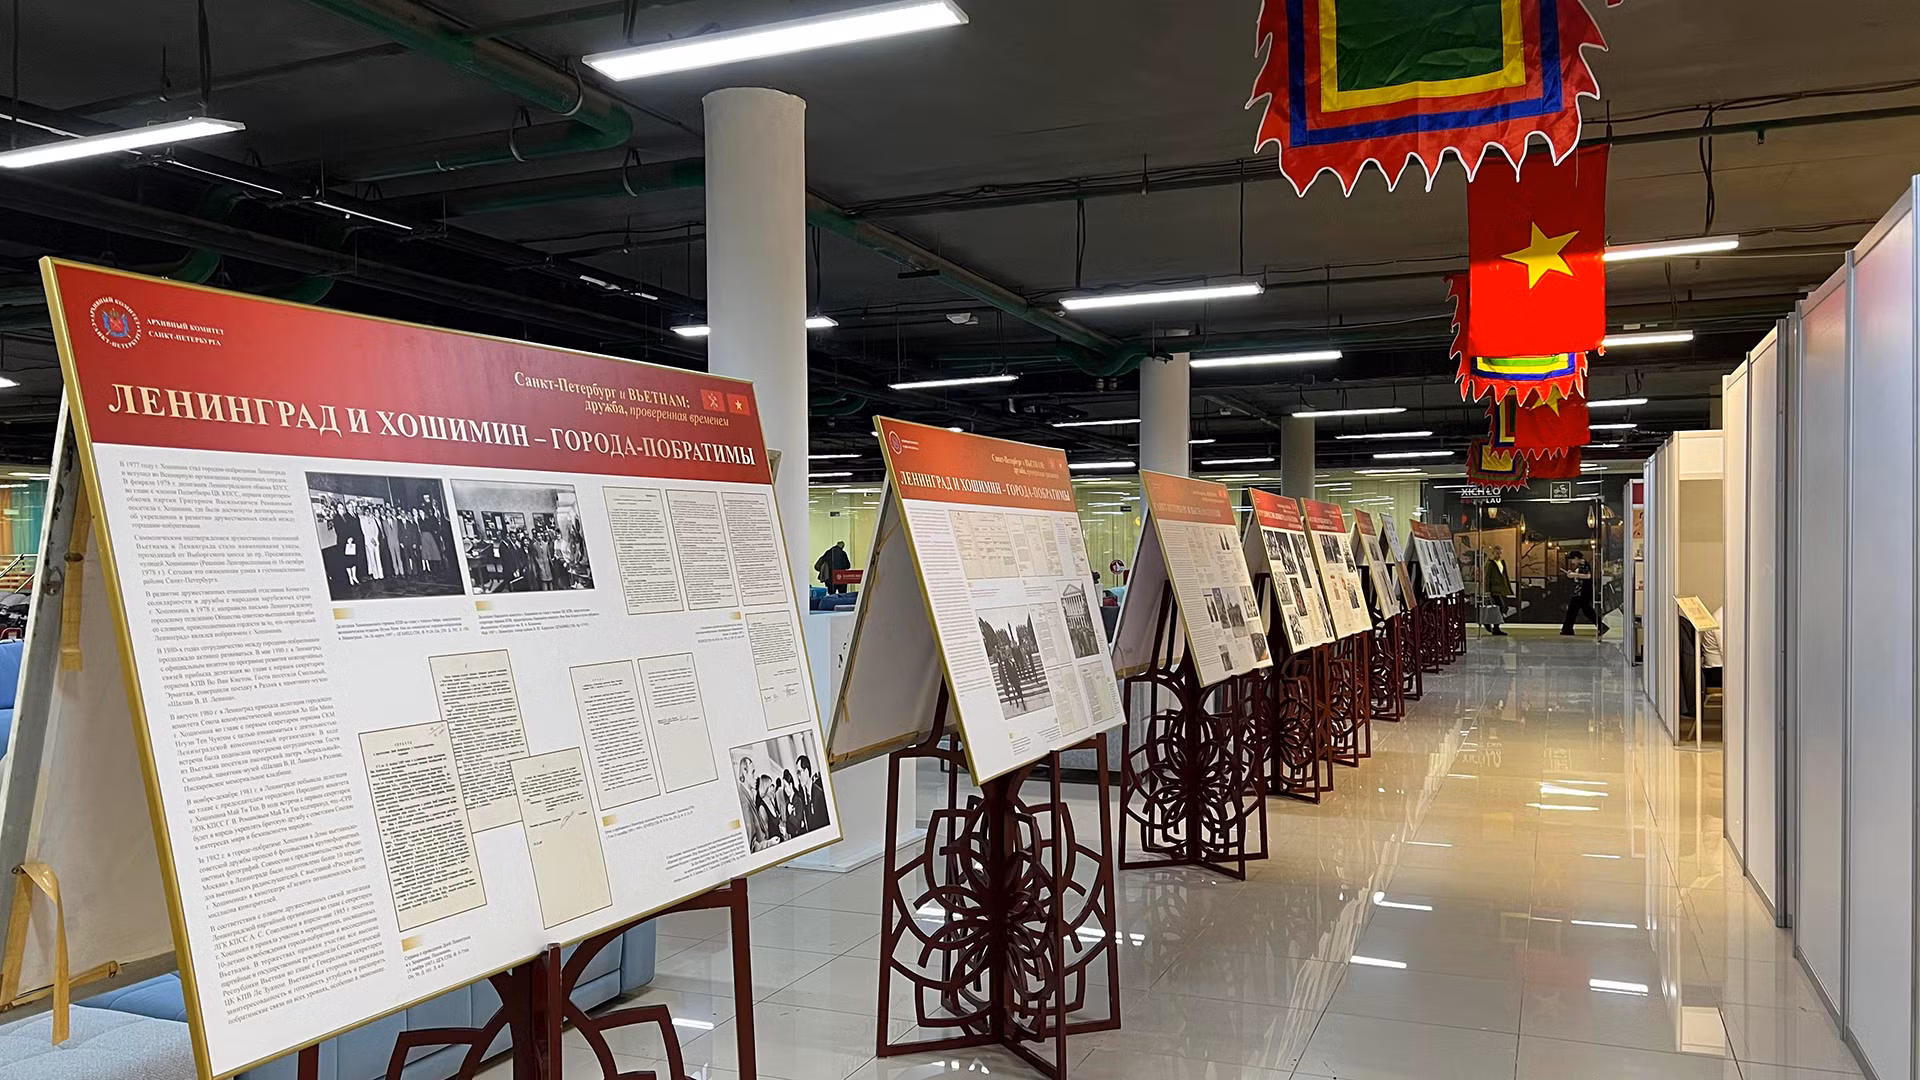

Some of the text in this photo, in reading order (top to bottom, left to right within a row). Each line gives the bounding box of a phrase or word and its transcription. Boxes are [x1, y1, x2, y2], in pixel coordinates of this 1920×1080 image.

[146, 318, 224, 335] АРХИВНЫЙ КОМИТЕТ
[148, 330, 222, 346] САНКТ-ПЕТЕРБУРГА
[514, 371, 616, 401] Санкт-Петербург
[628, 388, 690, 408] ВЬЕТНАМ:
[108, 383, 343, 438] ЛЕНИНГРАД
[345, 407, 371, 434] И
[375, 410, 530, 447] ХОШИМИН
[550, 428, 756, 466] ГОРОДА-ПОБРАТИМЫ
[585, 400, 729, 427] дружба, проверенная временем
[900, 470, 953, 491] ЛЕНИНГРАД
[952, 477, 960, 490] И
[960, 478, 1001, 494] ХОШИМИН
[1006, 483, 1070, 501] ГОРОДА-ПОБРАТИМЫ
